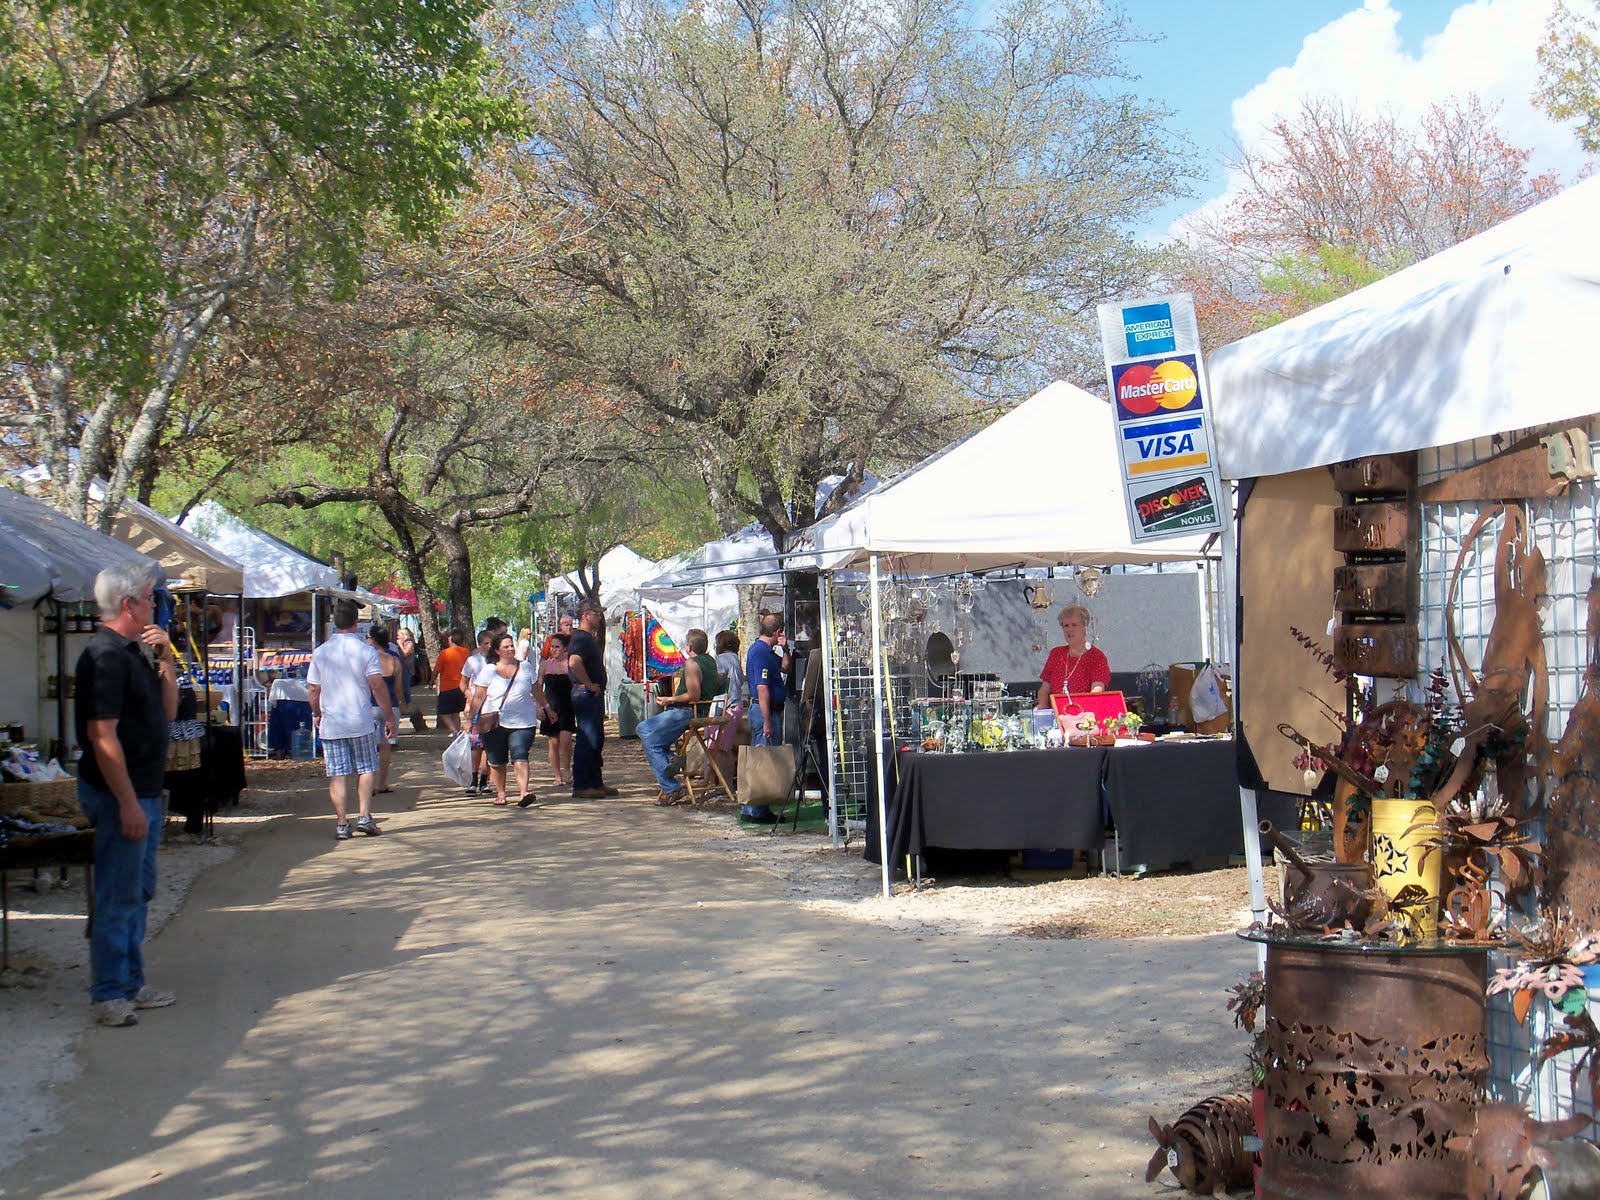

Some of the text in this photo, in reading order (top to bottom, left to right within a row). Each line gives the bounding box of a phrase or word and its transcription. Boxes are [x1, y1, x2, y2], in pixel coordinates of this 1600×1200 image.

[1125, 320, 1169, 333] AMERICAN
[1136, 330, 1174, 341] EXPRESS
[1120, 376, 1195, 399] MasterCard
[1137, 433, 1194, 459] VISA
[1139, 483, 1205, 517] DISCOVER
[1181, 514, 1211, 526] NOVUS
